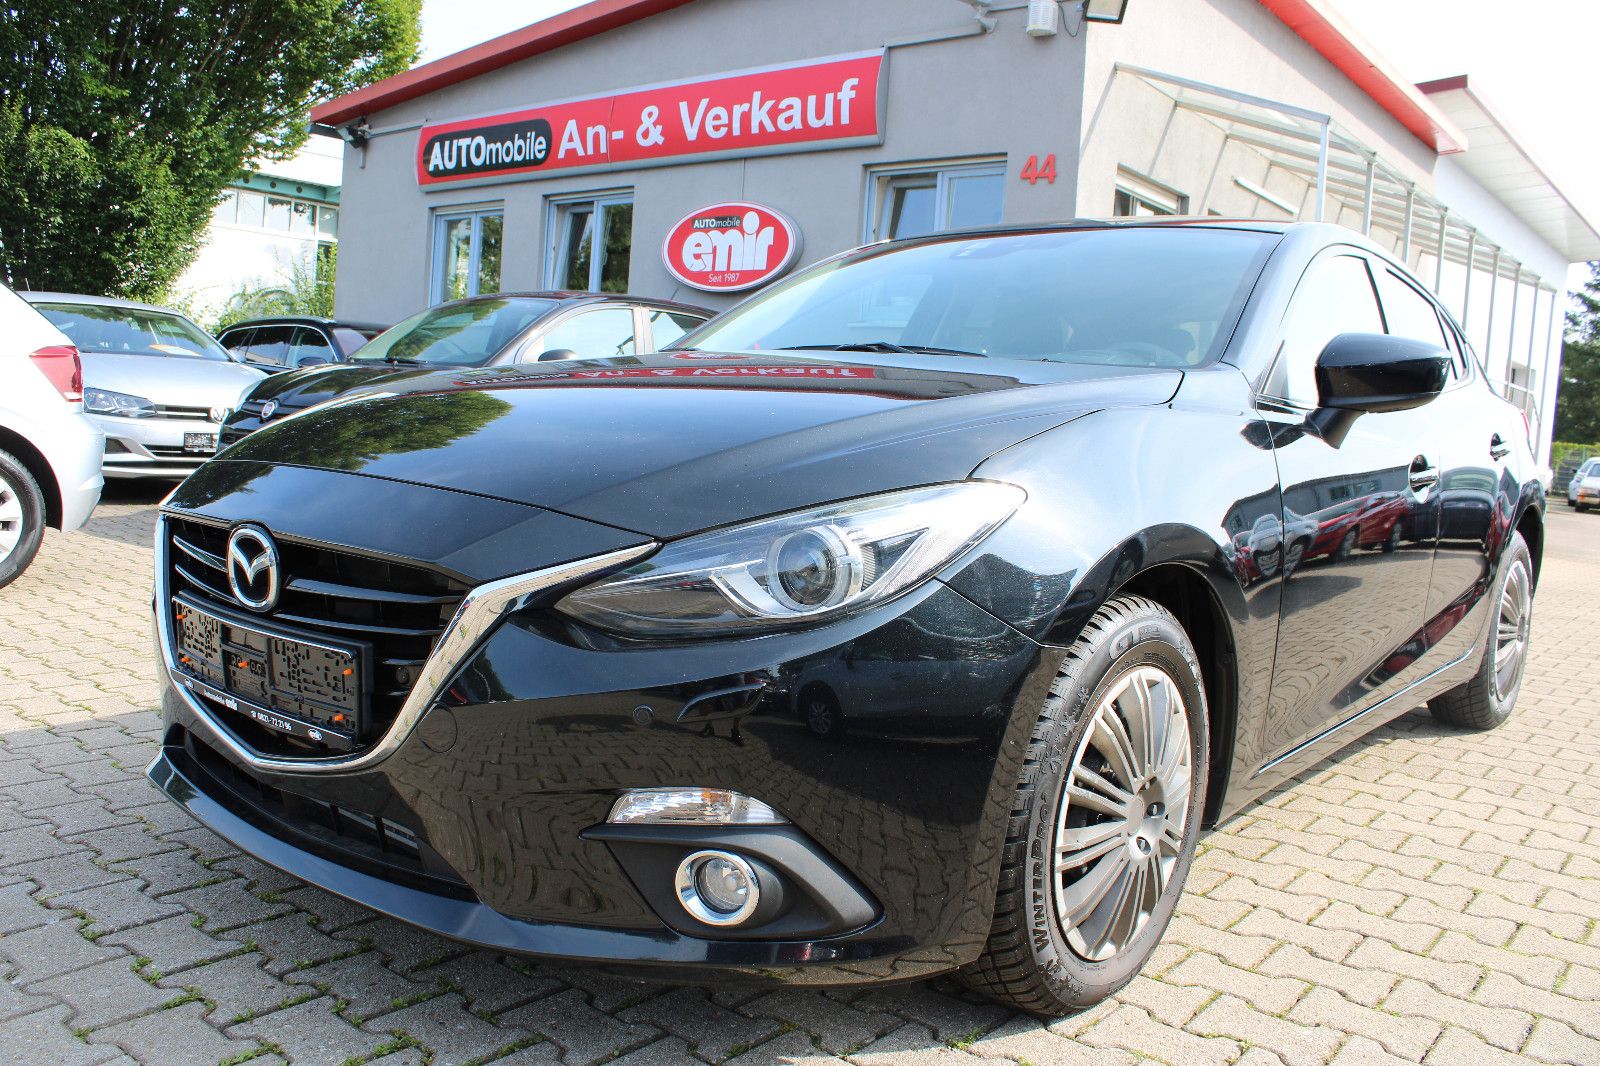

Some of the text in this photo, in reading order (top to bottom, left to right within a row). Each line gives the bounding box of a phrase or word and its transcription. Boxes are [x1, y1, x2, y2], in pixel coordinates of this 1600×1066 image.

[428, 77, 860, 172] AUTOmobile An- & Verkauf
[1020, 153, 1057, 185] 44
[693, 217, 741, 229] AUTOmobile
[682, 211, 775, 272] emir
[708, 273, 740, 283] Seit 1987
